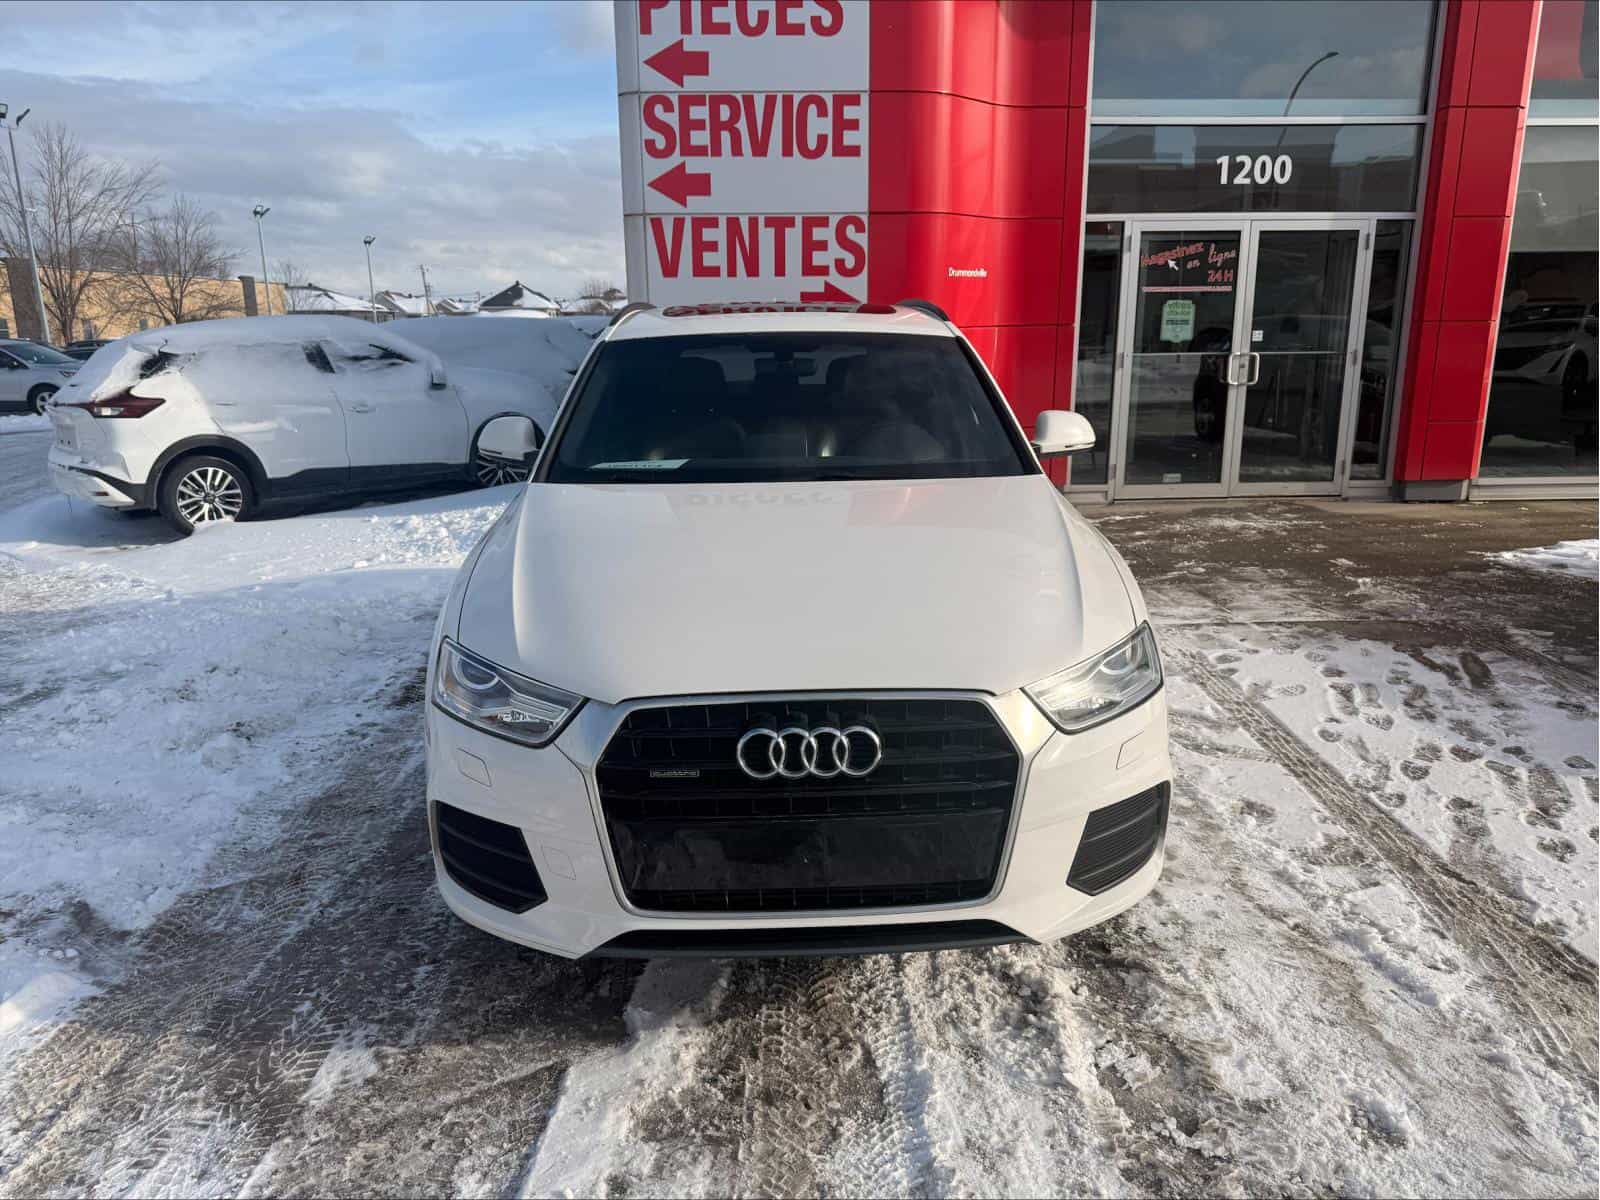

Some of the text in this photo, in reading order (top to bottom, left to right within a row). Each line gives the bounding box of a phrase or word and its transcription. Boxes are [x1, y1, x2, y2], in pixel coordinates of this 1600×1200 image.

[643, 94, 861, 160] SERVICE
[1215, 154, 1293, 185] 1200
[650, 215, 867, 279] VENTES
